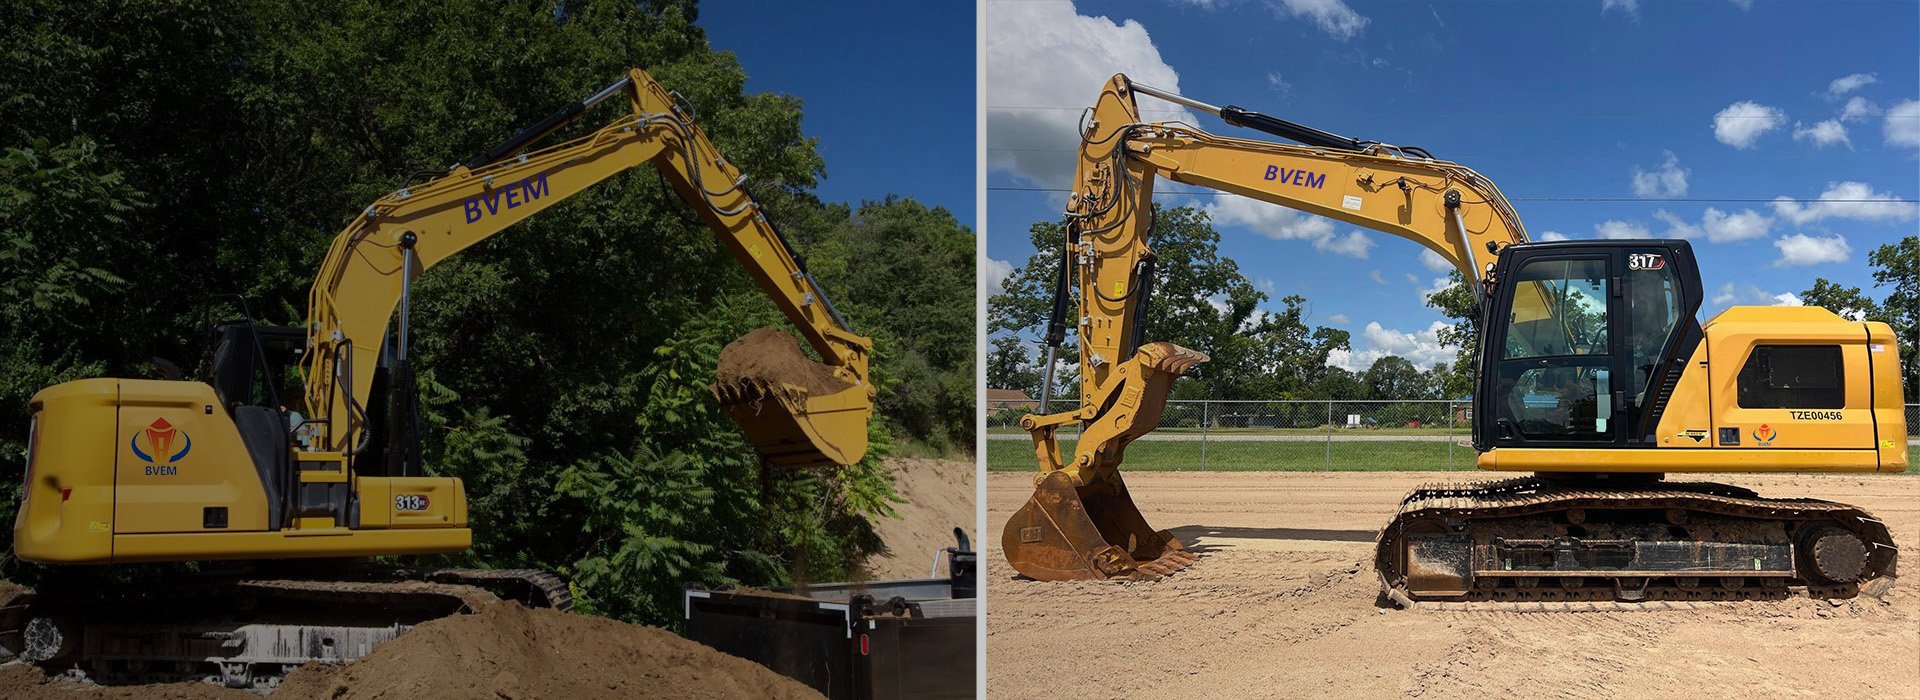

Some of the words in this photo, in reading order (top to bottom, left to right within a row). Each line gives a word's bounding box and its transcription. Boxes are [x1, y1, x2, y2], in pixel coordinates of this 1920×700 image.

[1264, 165, 1326, 189] BVEM
[463, 172, 549, 224] BVEM
[1629, 255, 1655, 268] 317
[1790, 411, 1843, 420] TZE00456
[145, 466, 177, 476] BVEM
[396, 495, 420, 510] 313
